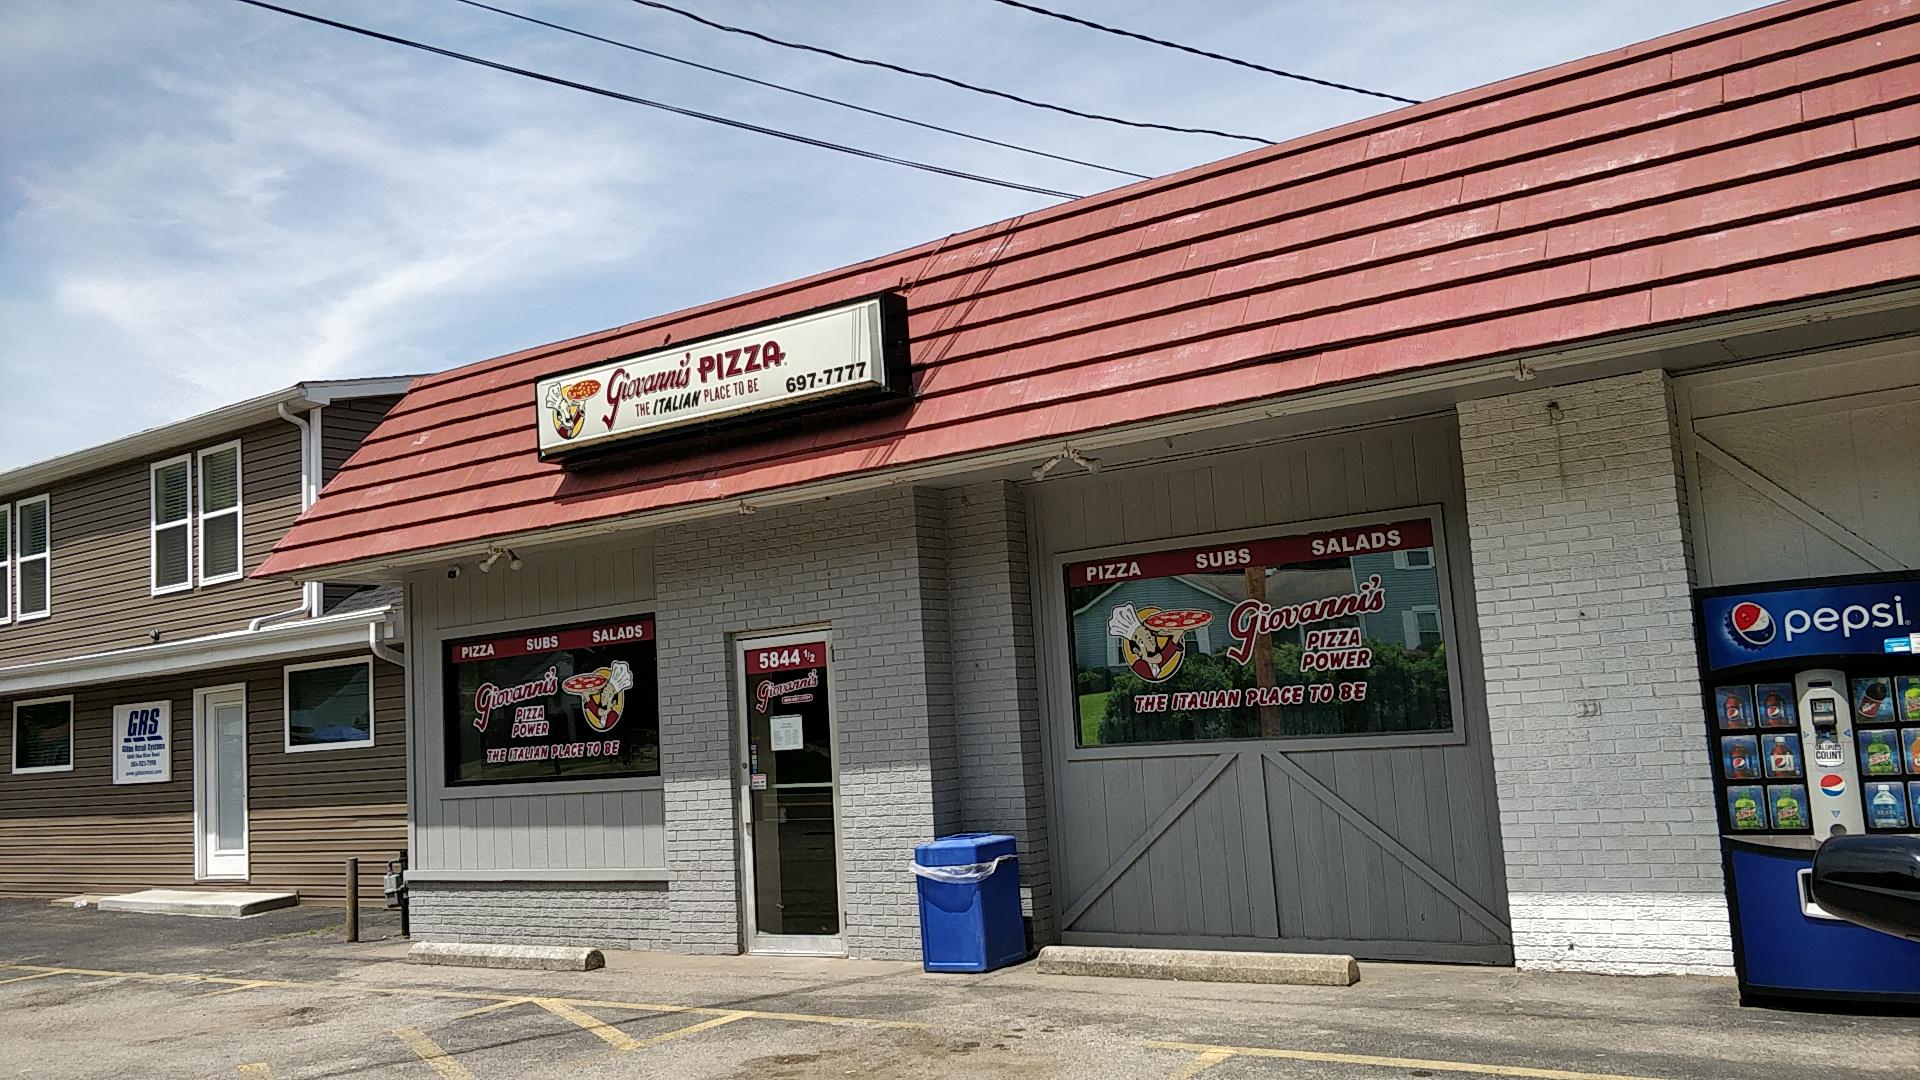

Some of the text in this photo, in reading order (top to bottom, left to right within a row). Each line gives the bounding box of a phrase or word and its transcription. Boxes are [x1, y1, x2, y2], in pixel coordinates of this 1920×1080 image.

[602, 340, 786, 432] Giovanni's PIZZA
[785, 361, 868, 394] 697-7777
[635, 377, 759, 417] THE ITALIAN PLACE TO BE
[1085, 529, 1402, 582] PIZZA SUBS SALADS
[1225, 574, 1387, 666] Giovanni's
[1784, 595, 1905, 642] pepsi
[461, 625, 643, 658] PIZZA SUBS SALADS
[1304, 627, 1361, 651] PIZZA
[759, 648, 801, 669] 5844
[1300, 648, 1373, 673] POWER
[473, 665, 559, 733] Giovanni's
[756, 668, 819, 714] Giovanni's
[1134, 682, 1368, 714] THE ITALIAN PLACE TO BE
[127, 707, 160, 737] GRS
[511, 720, 550, 738] POWER
[514, 705, 545, 721] PIZZA
[487, 740, 620, 763] THE ITALIAN PLACE TO BE
[1816, 750, 1842, 759] COUNT
